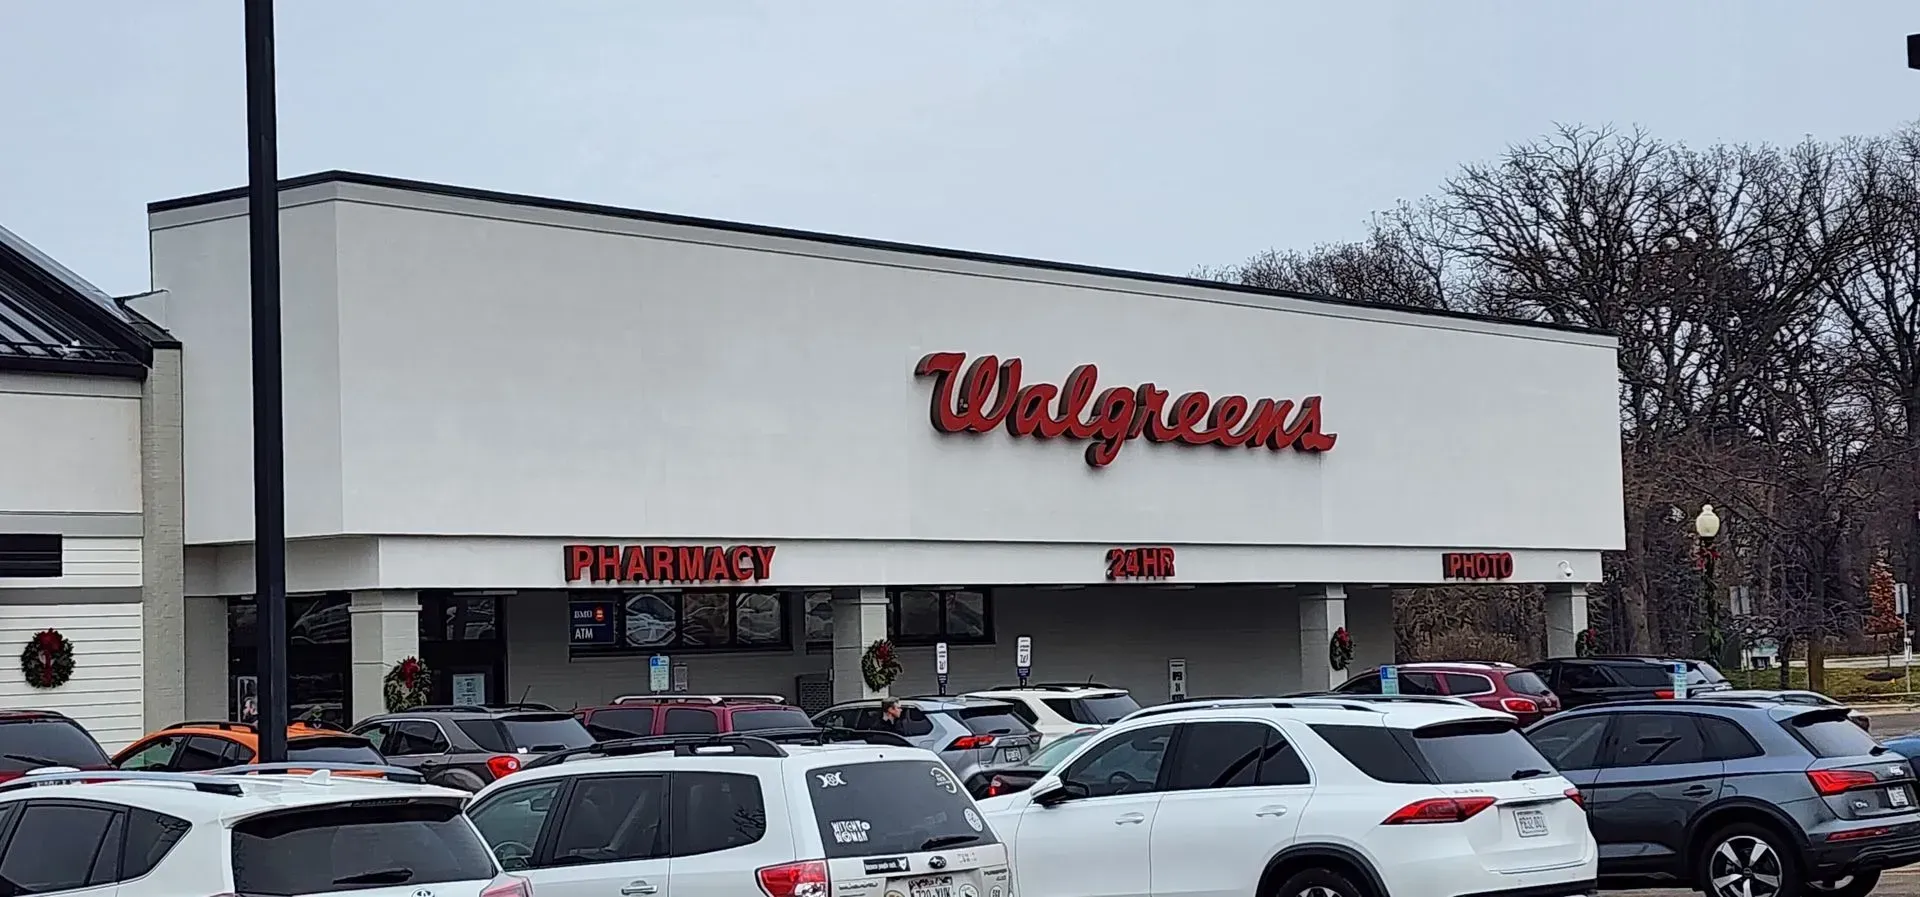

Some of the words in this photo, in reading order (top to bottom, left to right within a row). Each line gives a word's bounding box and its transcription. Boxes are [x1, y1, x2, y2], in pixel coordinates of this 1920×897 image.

[914, 352, 1338, 467] Walgreens
[565, 545, 776, 582] PHARMACY
[1443, 552, 1513, 579] PHOTO
[574, 610, 593, 619] BMO
[574, 627, 594, 640] ATM
[834, 830, 869, 843] WOMAN
